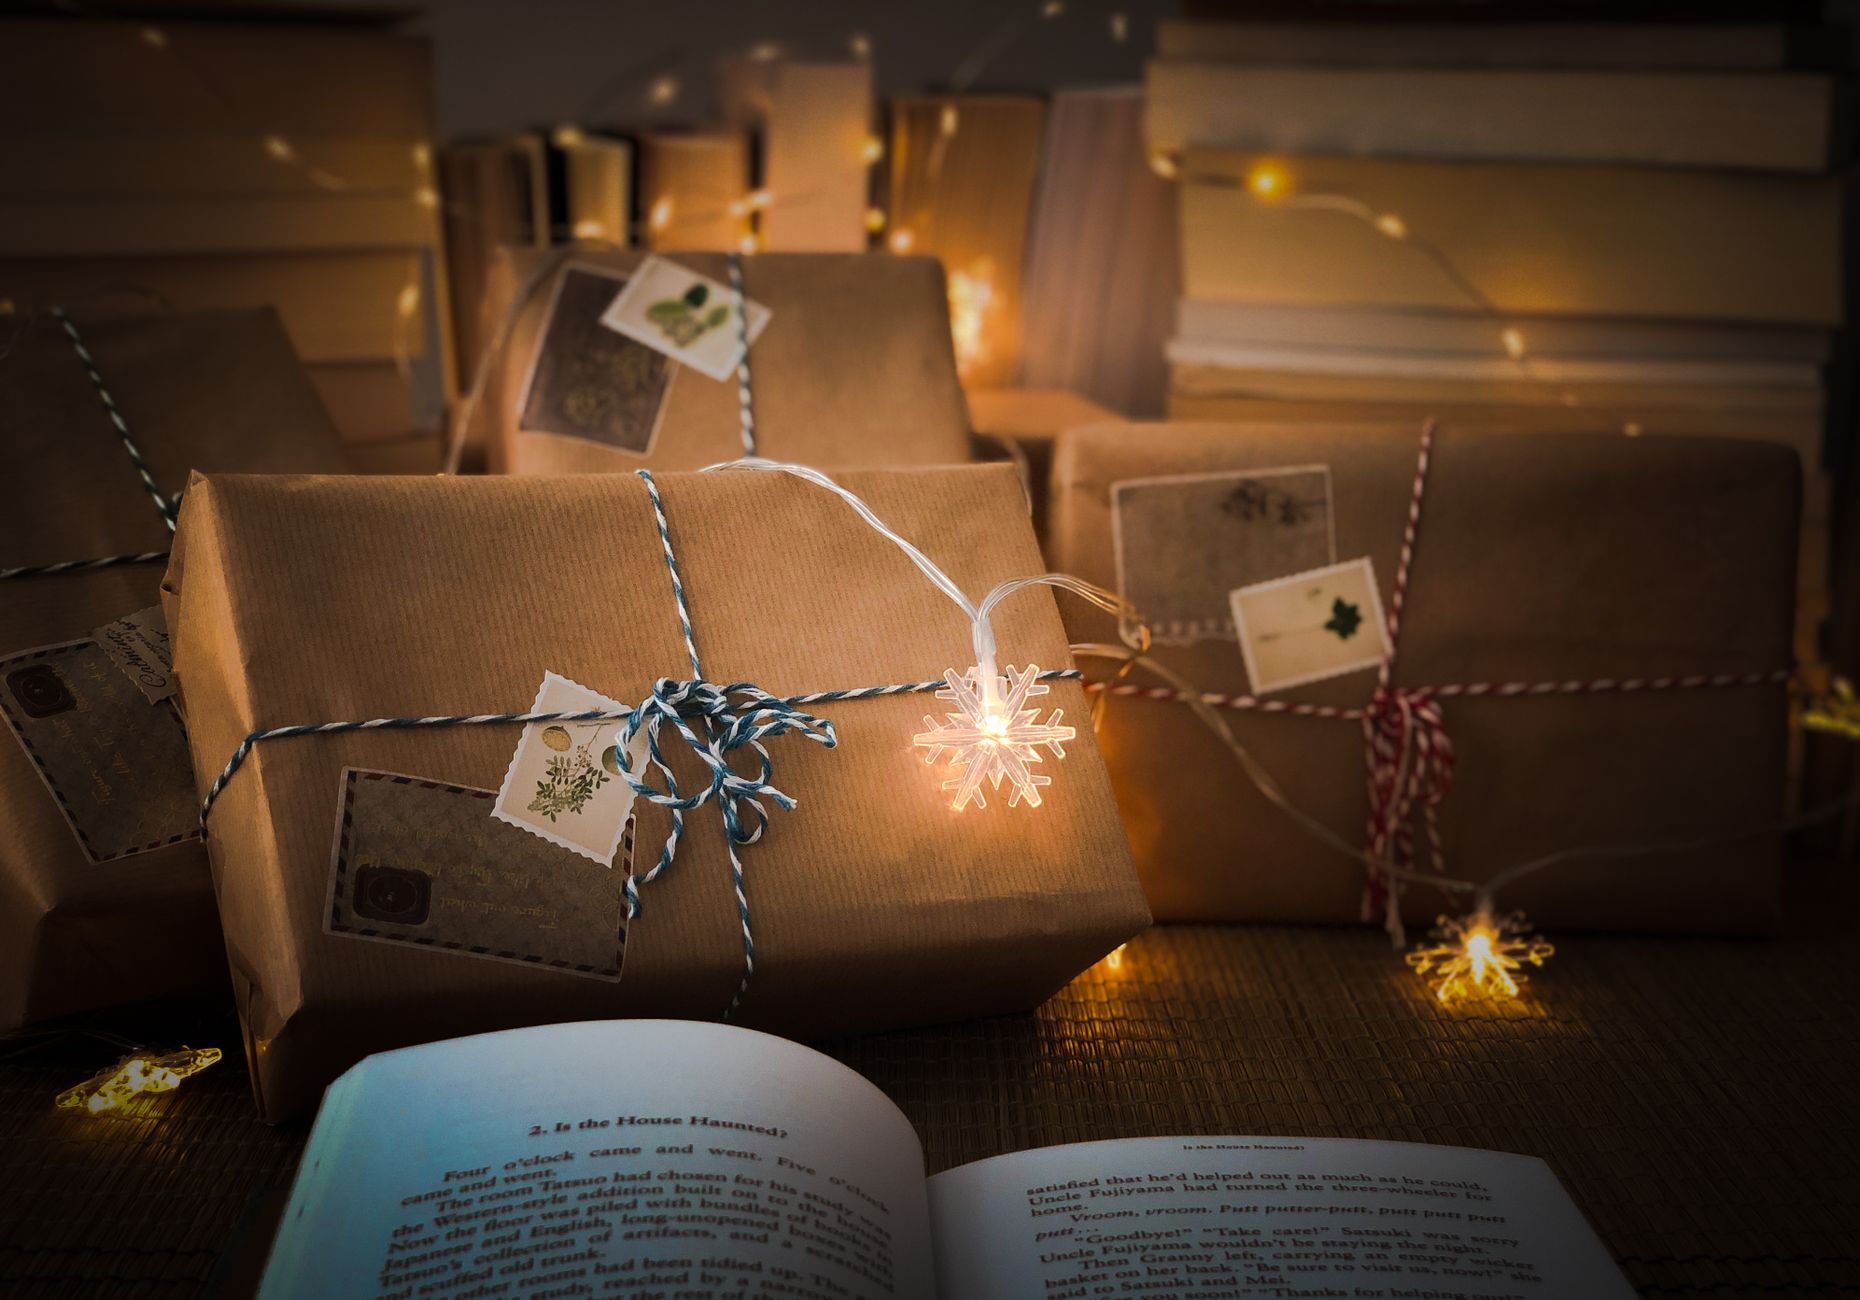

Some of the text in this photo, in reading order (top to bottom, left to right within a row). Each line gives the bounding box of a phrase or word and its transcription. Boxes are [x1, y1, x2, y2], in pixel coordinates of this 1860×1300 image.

[529, 1115, 788, 1138] 2. Is the House Haunted?
[400, 1168, 557, 1206] came and went.
[443, 1144, 890, 1214] Four o'clock came and went. Five o'clock
[1027, 1172, 1488, 1196] satisfied that he'd helped out as much as he could,
[435, 1170, 892, 1240] The room Tatsuo had chosen for his study was
[1028, 1182, 1493, 1206] Uncle Fujiyama had turned the three-wheeler for
[392, 1184, 888, 1249] the Western-style addition built on to the house
[1031, 1204, 1089, 1218] home.
[1070, 1204, 1506, 1224] Vroom, vroom. Putt putter-putt, putt putt putt
[384, 1212, 893, 1279] Japanese and English, long-unopened boxes with
[387, 1198, 893, 1267] Now the floor was piled with bundles of books in
[1074, 1226, 1520, 1248] "Goodbye!" "Take care!" Satsuki was sorry
[379, 1261, 463, 1288] Tatsuo's
[473, 1238, 576, 1266] collection
[588, 1230, 612, 1245] of
[623, 1226, 717, 1241] artifacts,
[729, 1231, 769, 1244] and
[781, 1239, 793, 1249] a
[805, 1247, 895, 1294] scratched
[1039, 1238, 1490, 1264] Uncle Fujiyama wouldn't be staying the night.
[1078, 1250, 1535, 1271] Then Granny left, carrying an empty wicker
[418, 1267, 493, 1294] scuffed
[499, 1257, 535, 1277] old
[541, 1249, 607, 1268] trunk.
[518, 1267, 587, 1287] rooms
[595, 1258, 635, 1275] had
[643, 1257, 693, 1270] been
[701, 1257, 763, 1273] tidied
[770, 1267, 803, 1281] up.
[809, 1272, 848, 1294] The
[604, 1273, 689, 1289] reached
[700, 1273, 726, 1286] by
[737, 1276, 749, 1286] a
[1045, 1273, 1109, 1289] basket
[1115, 1268, 1140, 1279] on
[1147, 1265, 1179, 1276] her
[1186, 1263, 1239, 1275] back.
[1244, 1262, 1280, 1273] "Be
[1287, 1263, 1328, 1272] sure
[1334, 1263, 1355, 1272] to
[1361, 1263, 1401, 1273] visit
[1408, 1264, 1438, 1276] us,
[1510, 1271, 1543, 1284] she
[1047, 1286, 1087, 1300] said
[1093, 1284, 1114, 1294] to
[1120, 1278, 1194, 1292] Satsuki
[1201, 1275, 1238, 1287] and
[1246, 1275, 1291, 1287] Mei.
[1354, 1287, 1384, 1297] for
